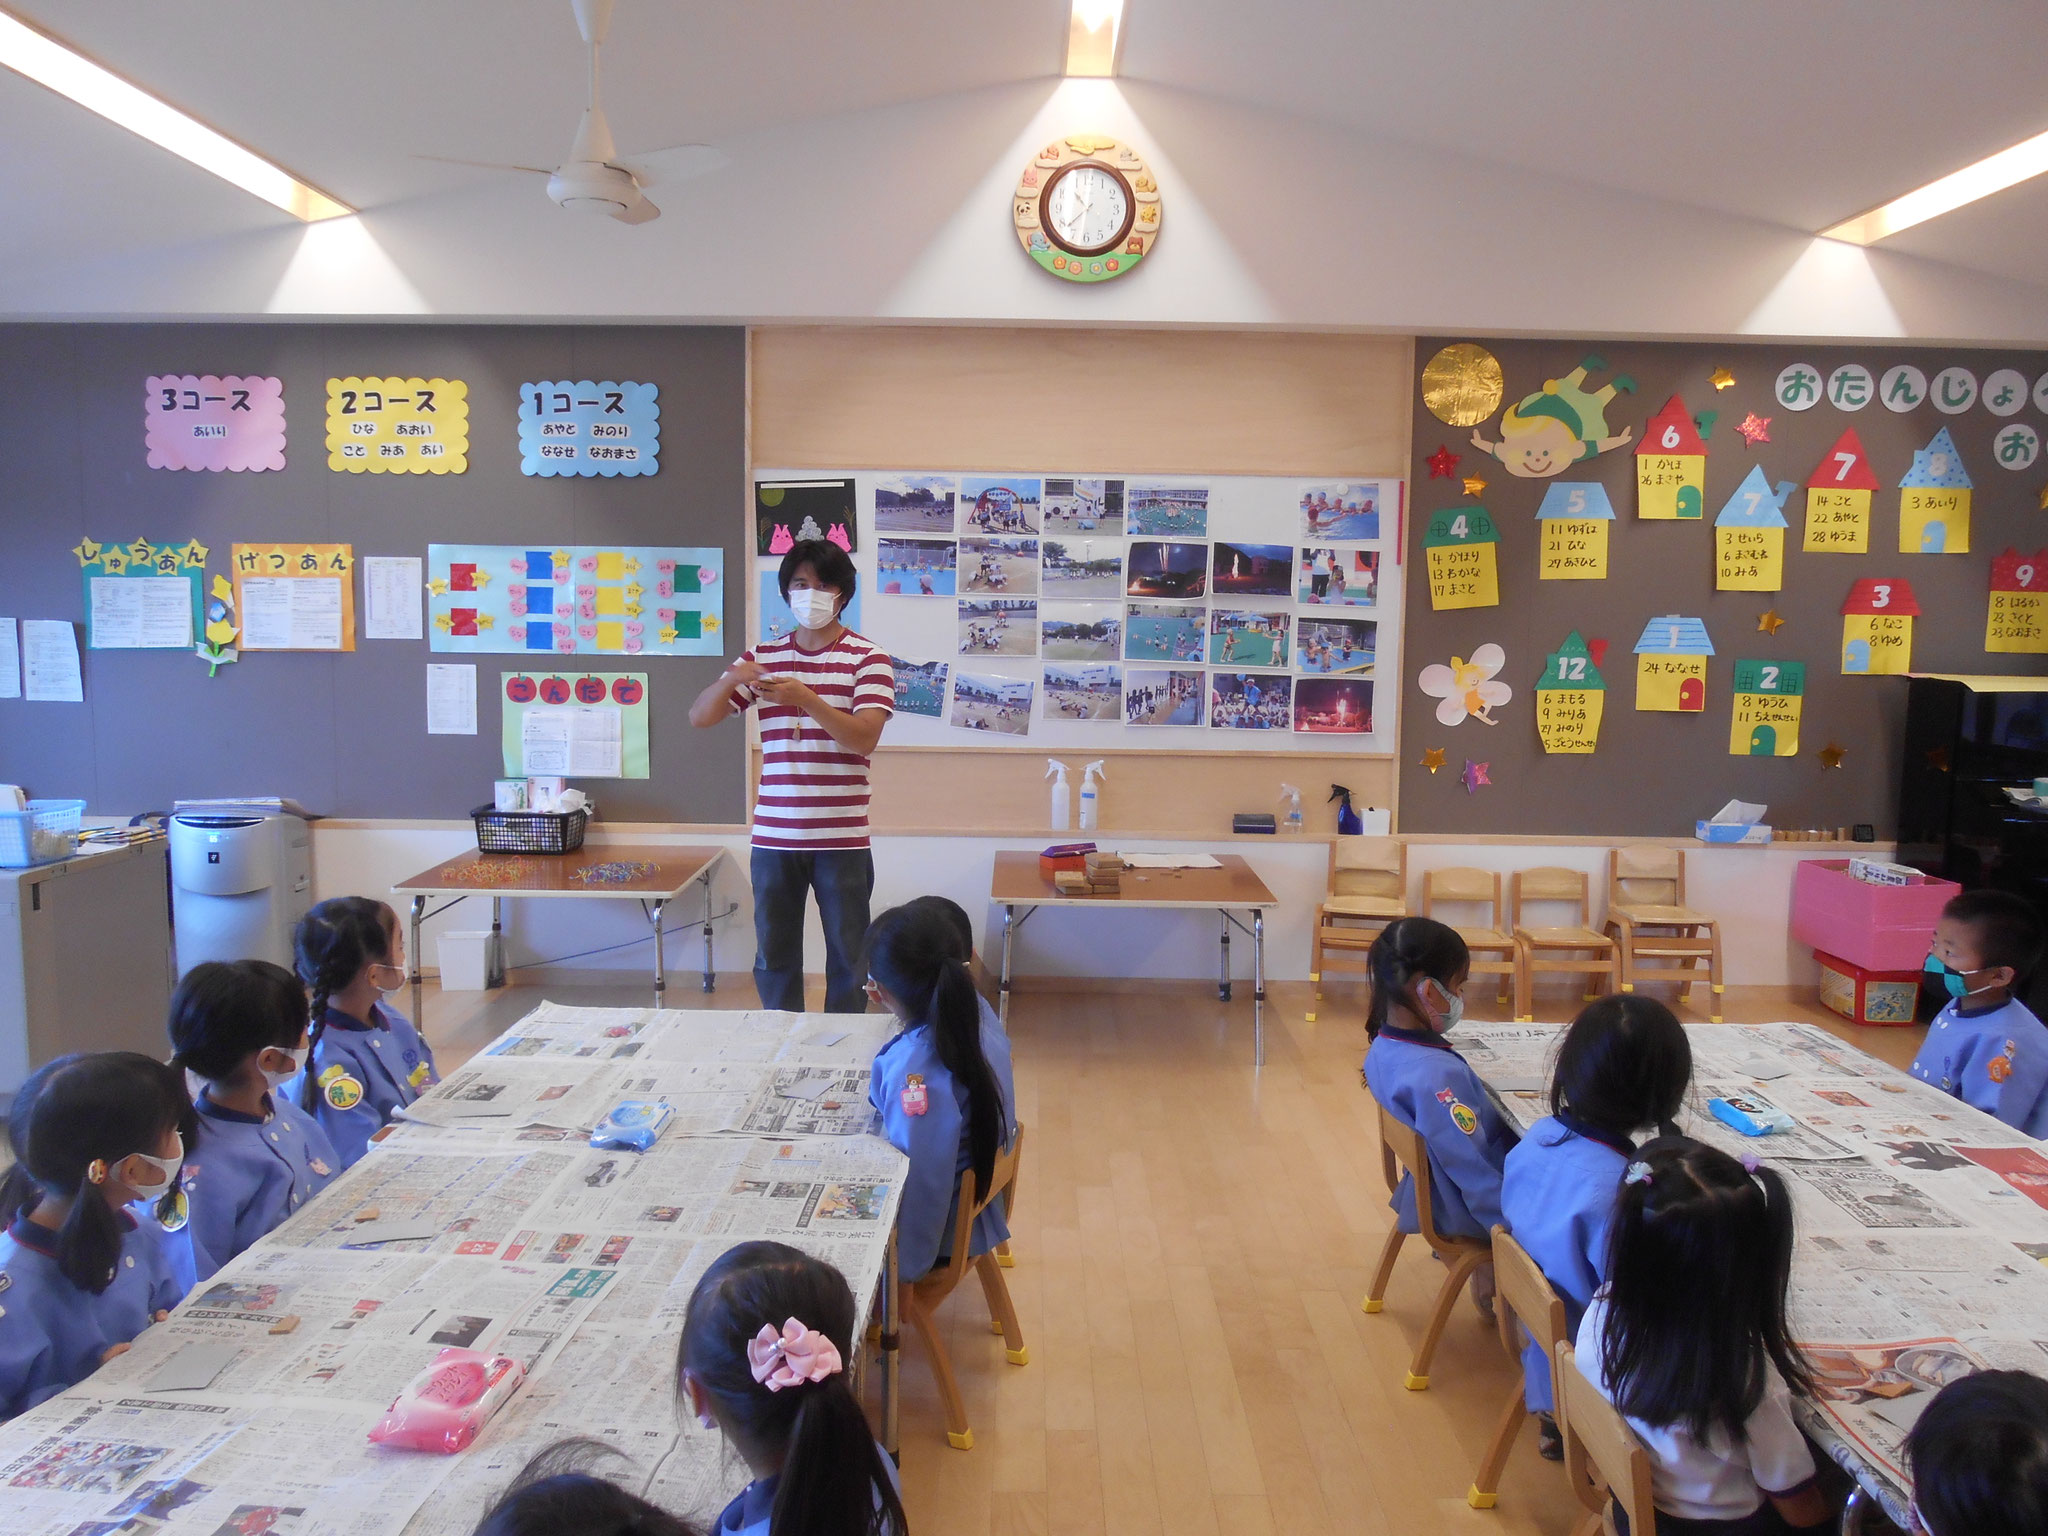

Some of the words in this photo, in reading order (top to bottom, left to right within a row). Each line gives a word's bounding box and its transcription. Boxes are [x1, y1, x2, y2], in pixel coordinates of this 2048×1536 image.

[1083, 175, 1094, 186] 12
[1109, 188, 1116, 200] 2
[1055, 202, 1062, 214] 9
[1113, 204, 1120, 216] 3
[1106, 219, 1114, 231] 4
[1070, 228, 1077, 239] 7
[1083, 232, 1090, 243] 6
[1096, 229, 1104, 241] 5
[1781, 370, 2048, 407] おたんじょ
[162, 388, 251, 411] 3コース
[341, 391, 436, 414] 2コース
[534, 392, 625, 415] 1コース
[193, 426, 226, 437] あいり
[352, 423, 374, 434] ひな
[396, 424, 432, 435] あおい
[543, 424, 576, 435] あやと
[593, 425, 628, 437] みのり
[1662, 425, 1680, 449] 6
[344, 446, 365, 456] こと
[380, 445, 404, 456] みあ
[421, 445, 443, 456] あい
[542, 445, 575, 458] ななせ
[590, 447, 637, 459] なおまさ
[1644, 459, 1648, 470] 1
[1834, 452, 1857, 481] 7
[1929, 453, 1948, 477] 8
[1656, 474, 1684, 486] まさや
[1568, 490, 1585, 513] 5
[1743, 492, 1762, 516] 7
[1816, 495, 1829, 506] 14
[1834, 495, 1852, 507] こと
[1912, 496, 1920, 509] 3
[1925, 496, 1957, 511] あいり
[1813, 513, 1828, 524] 22
[1833, 512, 1860, 523] あやと
[1450, 515, 1469, 539] 4
[1551, 524, 1562, 535] 11
[1567, 522, 1597, 535] ゆずは
[1725, 532, 1732, 545] 3
[1738, 533, 1764, 544] せいら
[1812, 531, 1826, 543] 28
[1830, 530, 1857, 542] ゆうま
[1548, 541, 1561, 551] 21
[1568, 540, 1586, 551] ひな
[81, 543, 204, 571] しゅうあん
[239, 552, 348, 572] げつあん
[1433, 553, 1443, 565] 4
[1724, 551, 1731, 561] 6
[1547, 559, 1561, 569] 27
[1433, 569, 1443, 580] 13
[1721, 568, 1731, 578] 10
[1734, 565, 1758, 577] みあ
[2015, 564, 2034, 588] 9
[1434, 584, 1445, 597] 17
[1448, 583, 1476, 596] まさと
[1872, 585, 1891, 608] 3
[1995, 596, 2005, 608] 8
[2010, 597, 2040, 608] はるか
[1870, 617, 1879, 630] 6
[1883, 617, 1903, 630] なこ
[1669, 626, 1680, 648] 1
[2005, 627, 2042, 639] なおまさ
[1869, 635, 1878, 647] 8
[1881, 635, 1903, 647] ゆめ
[1558, 657, 1587, 680] 12
[1644, 662, 1660, 674] 24
[1665, 662, 1700, 674] ななせ
[1760, 666, 1779, 689] 2
[513, 681, 635, 703] こんだて
[1544, 694, 1552, 705] 6
[1557, 694, 1586, 705] まもる
[1742, 695, 1751, 707] 8
[1758, 697, 1789, 709] ゆうひ
[1542, 708, 1550, 720] 9
[1556, 709, 1587, 720] みりあ
[1739, 711, 1749, 722] 11
[1556, 722, 1584, 735] みのり
